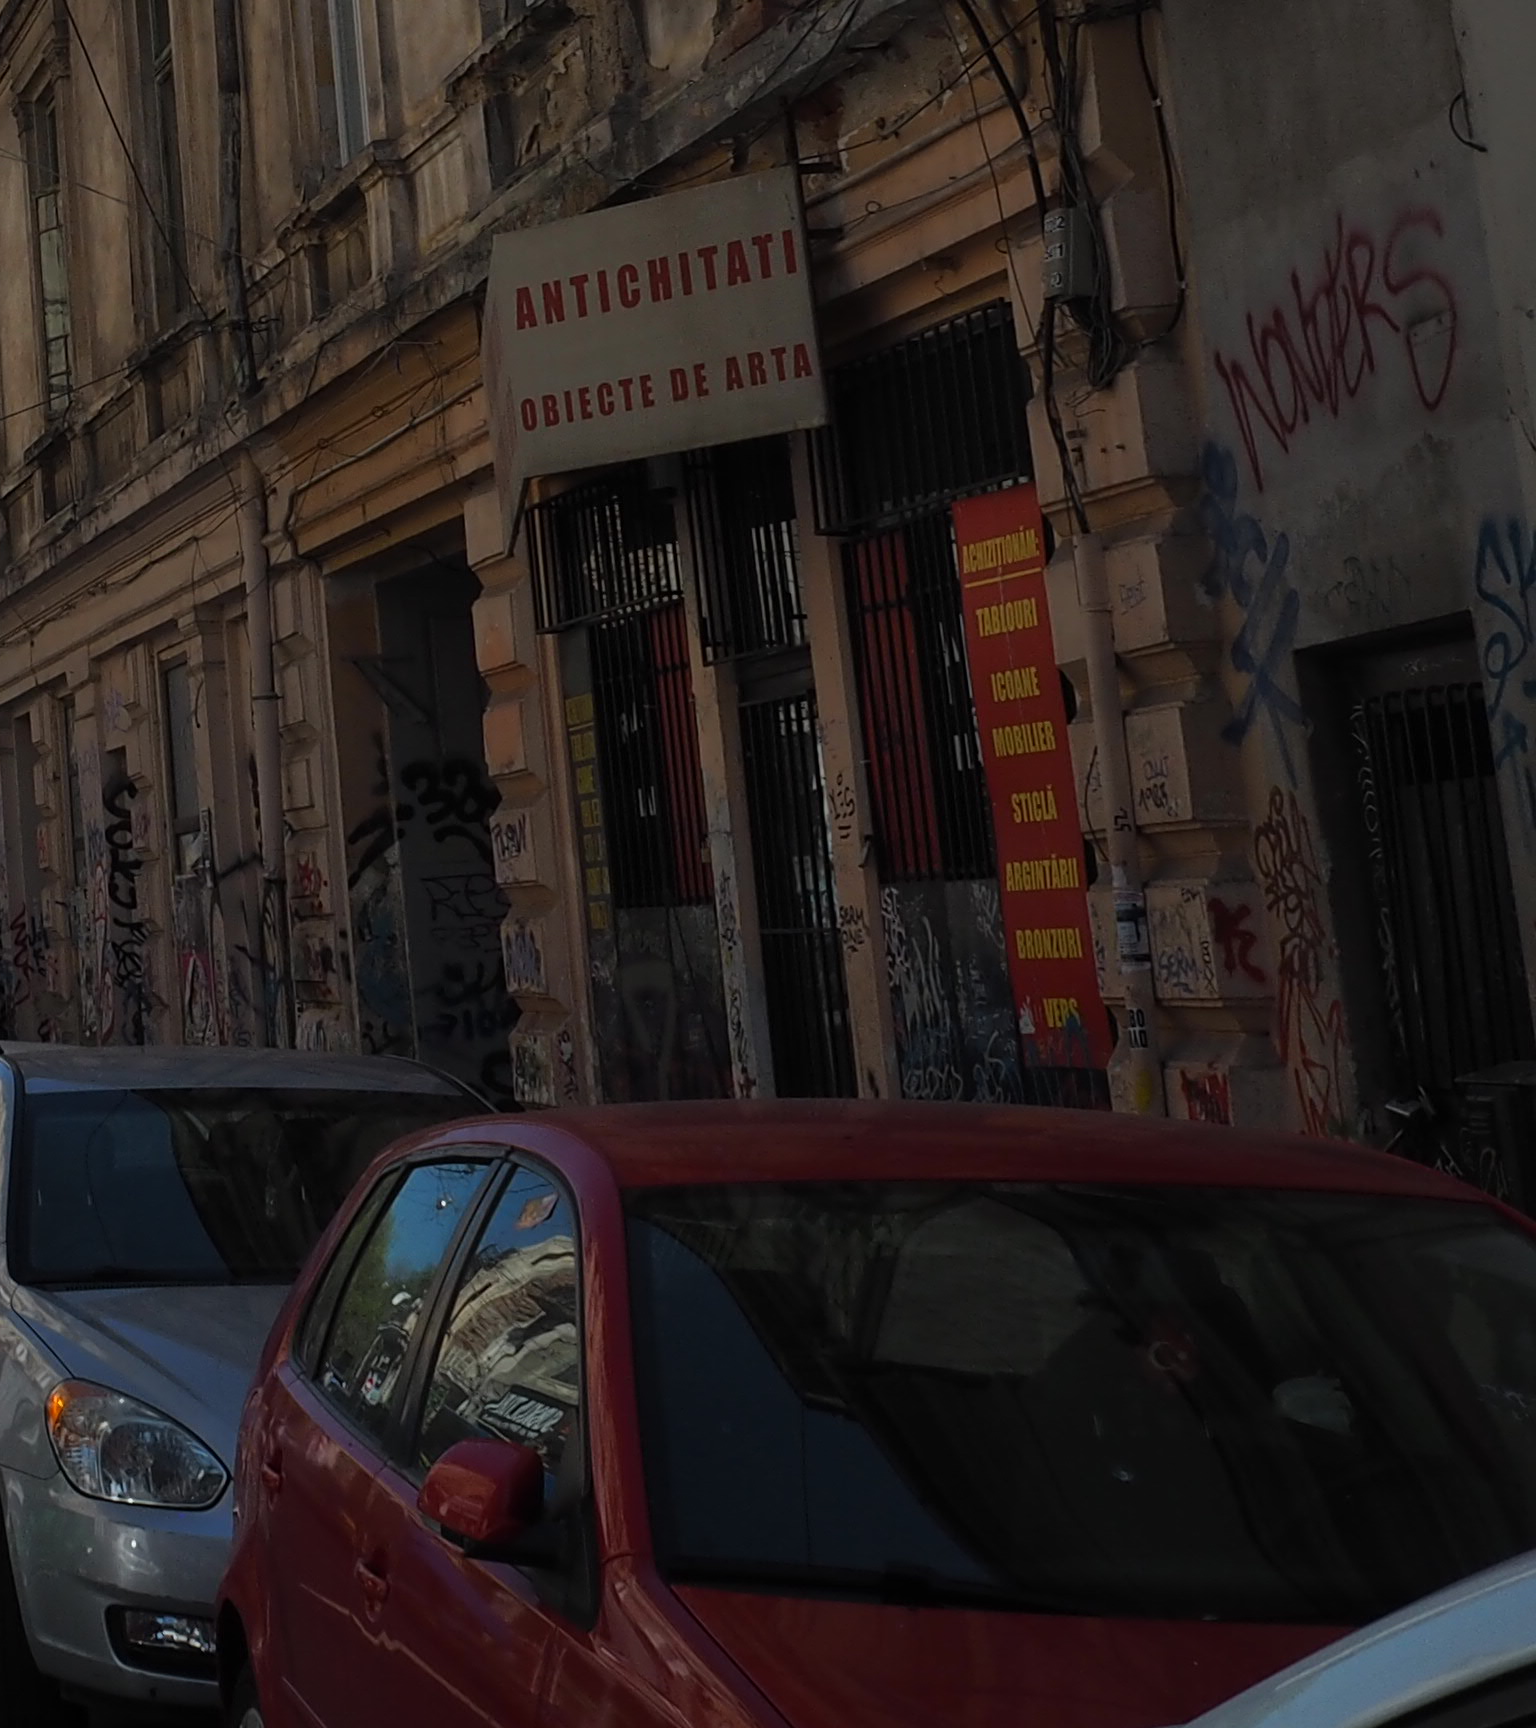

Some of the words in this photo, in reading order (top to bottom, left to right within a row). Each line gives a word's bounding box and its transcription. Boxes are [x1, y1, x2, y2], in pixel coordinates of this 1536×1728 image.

[516, 229, 797, 330] ANTICHITATI
[520, 374, 655, 431] OBIECTE
[670, 363, 709, 402] DE
[726, 343, 812, 392] ARTA
[975, 596, 1039, 638] TABLOURI
[990, 666, 1041, 703] ICOANE
[991, 720, 1057, 757] MOBILIER
[1011, 783, 1057, 824] STICLĂ
[1006, 853, 1079, 892] ARGINTĂRII
[1015, 927, 1083, 959] BRONZURI
